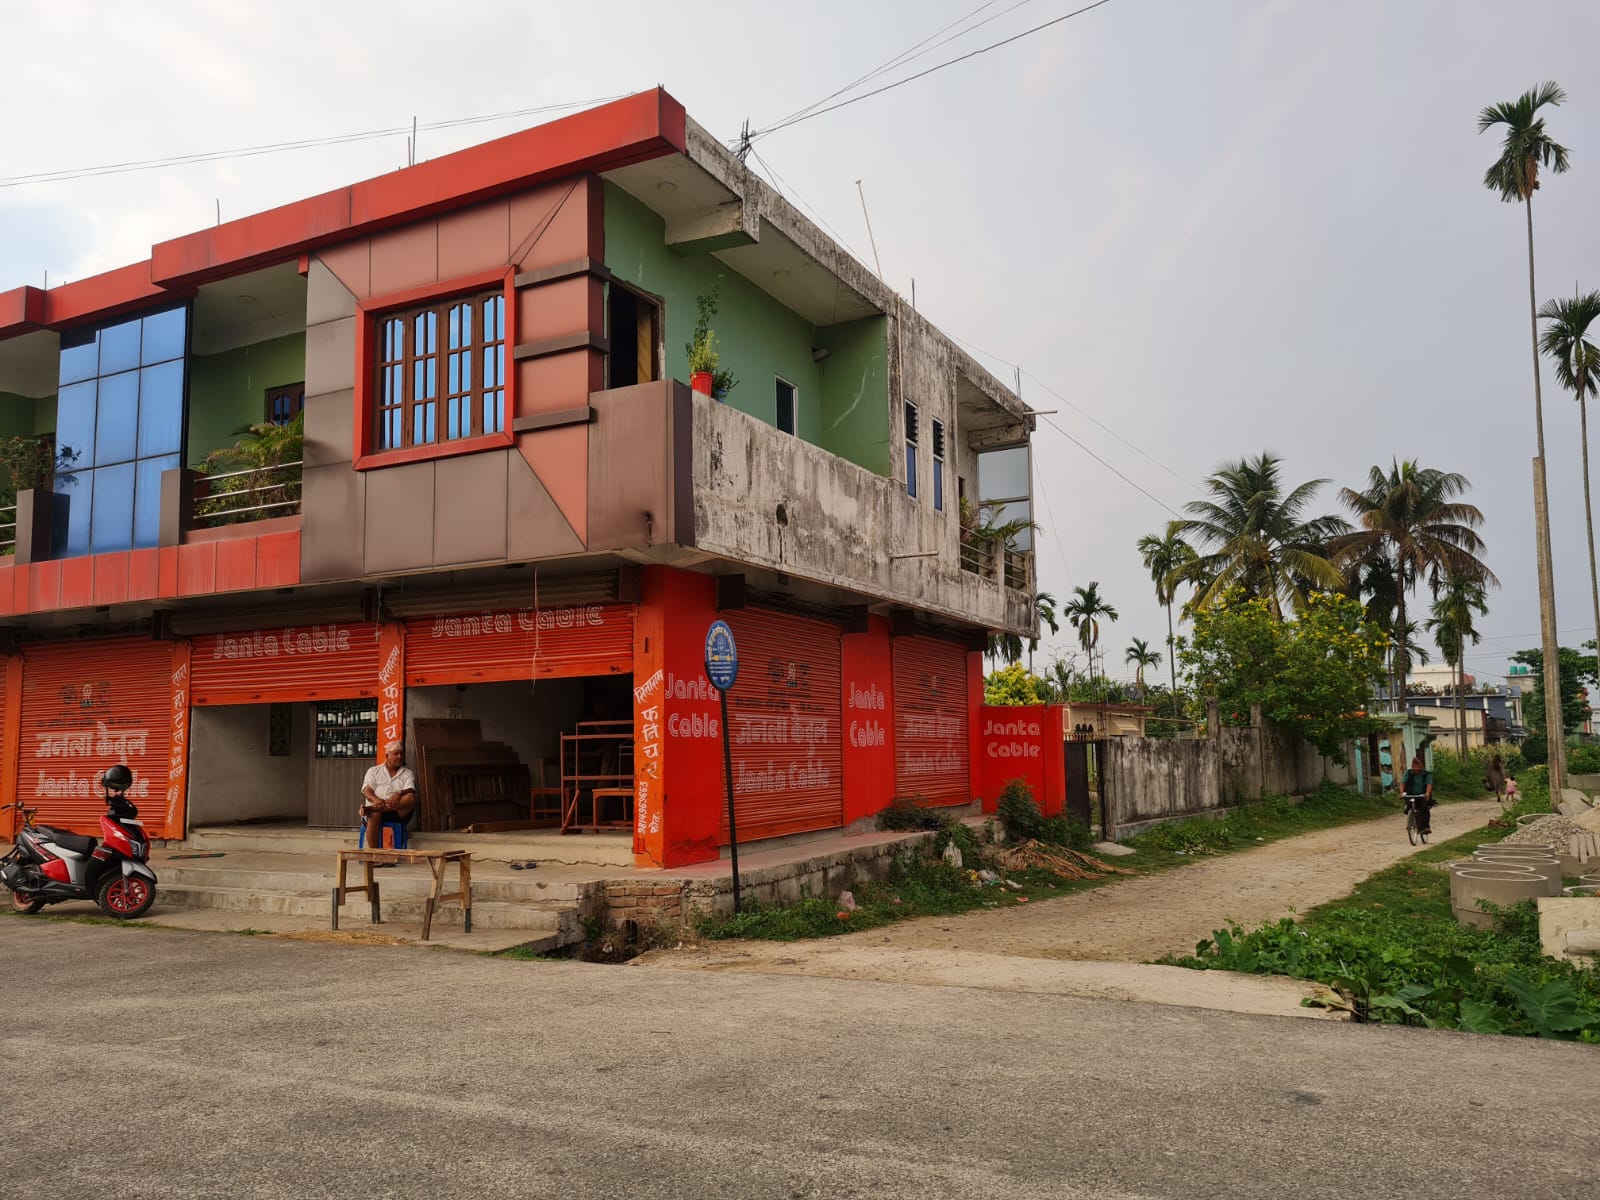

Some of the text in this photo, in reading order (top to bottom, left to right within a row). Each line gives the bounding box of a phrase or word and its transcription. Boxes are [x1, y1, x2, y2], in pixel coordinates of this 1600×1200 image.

[432, 603, 603, 638] Janta Cable
[213, 624, 350, 660] Janta Cable
[849, 681, 885, 710] Janta
[668, 713, 719, 738] Cable
[850, 720, 885, 747] Cable
[984, 720, 1040, 736] Janta
[987, 742, 1041, 758] Cable
[35, 770, 90, 797] Janta
[736, 760, 786, 793] Janta
